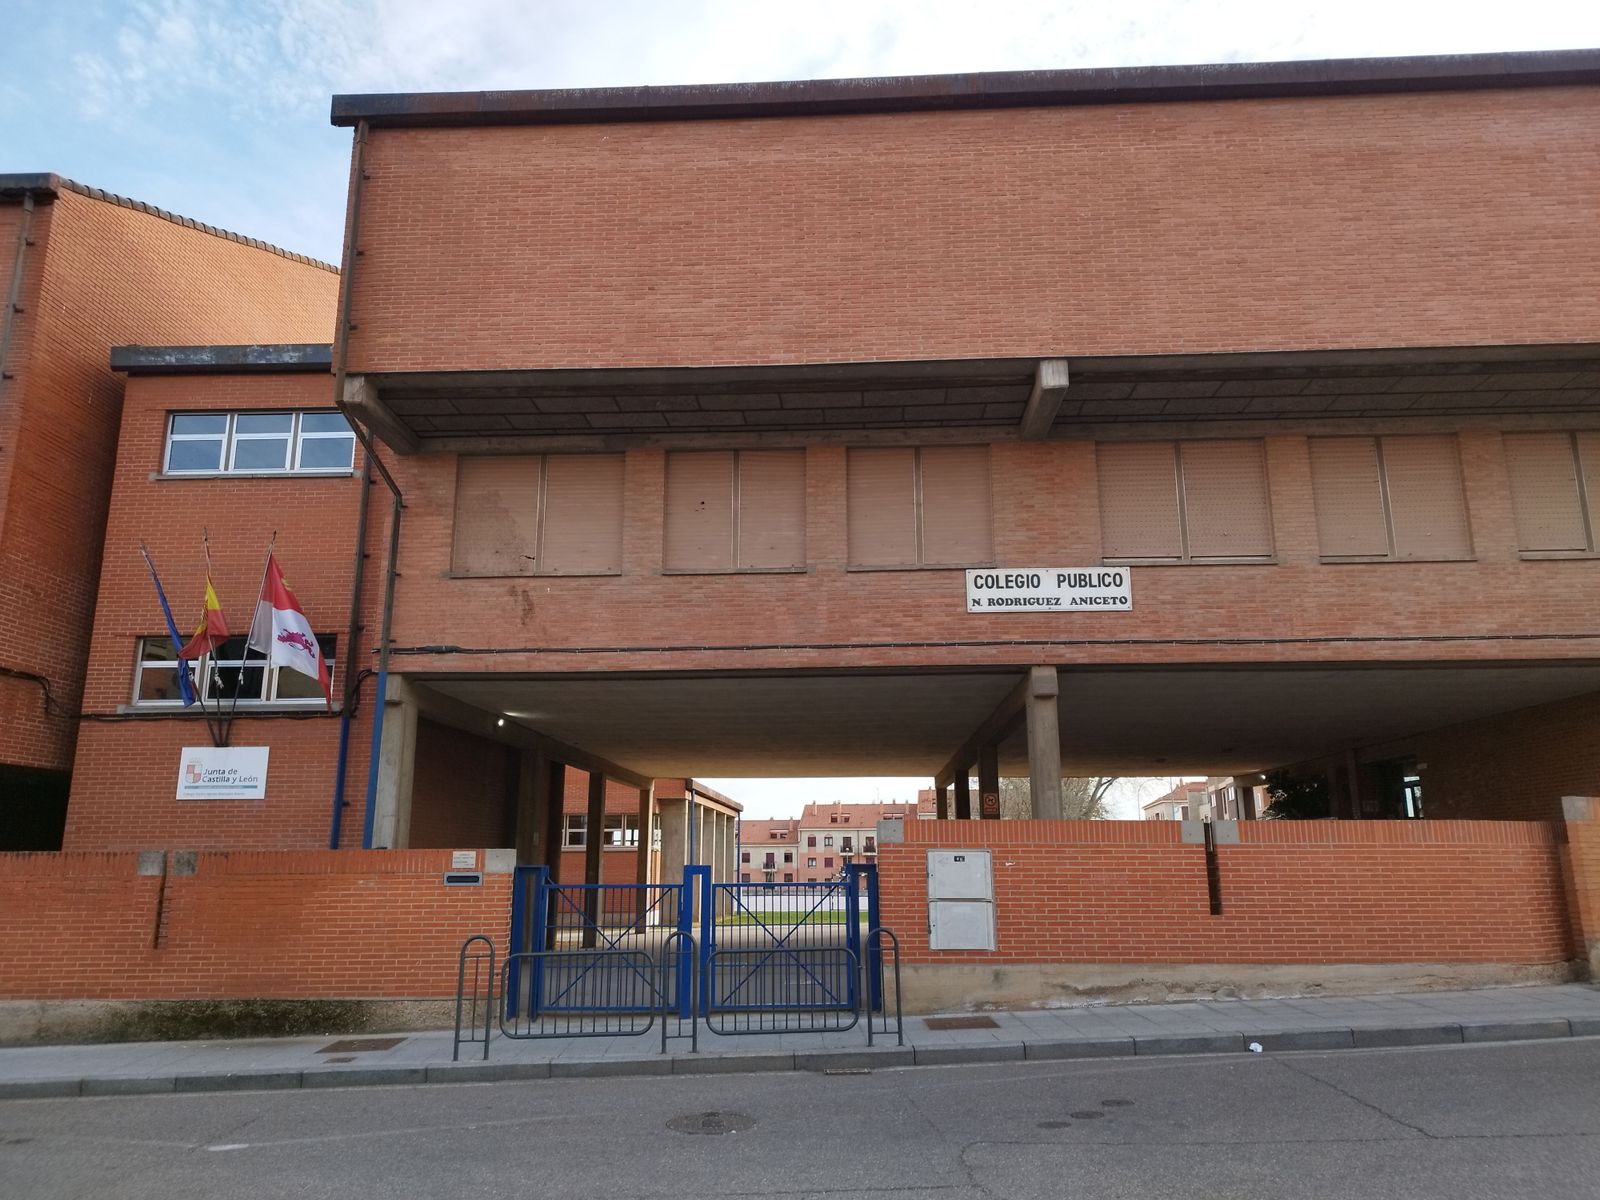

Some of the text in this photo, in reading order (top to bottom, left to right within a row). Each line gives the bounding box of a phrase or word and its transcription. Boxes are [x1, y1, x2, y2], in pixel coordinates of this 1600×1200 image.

[974, 572, 1123, 589] COLEGIO PUBLICO
[972, 595, 1128, 607] N. RODRIGUEZ ANICETO
[202, 775, 230, 783] Castilla
[239, 775, 258, 783] León
